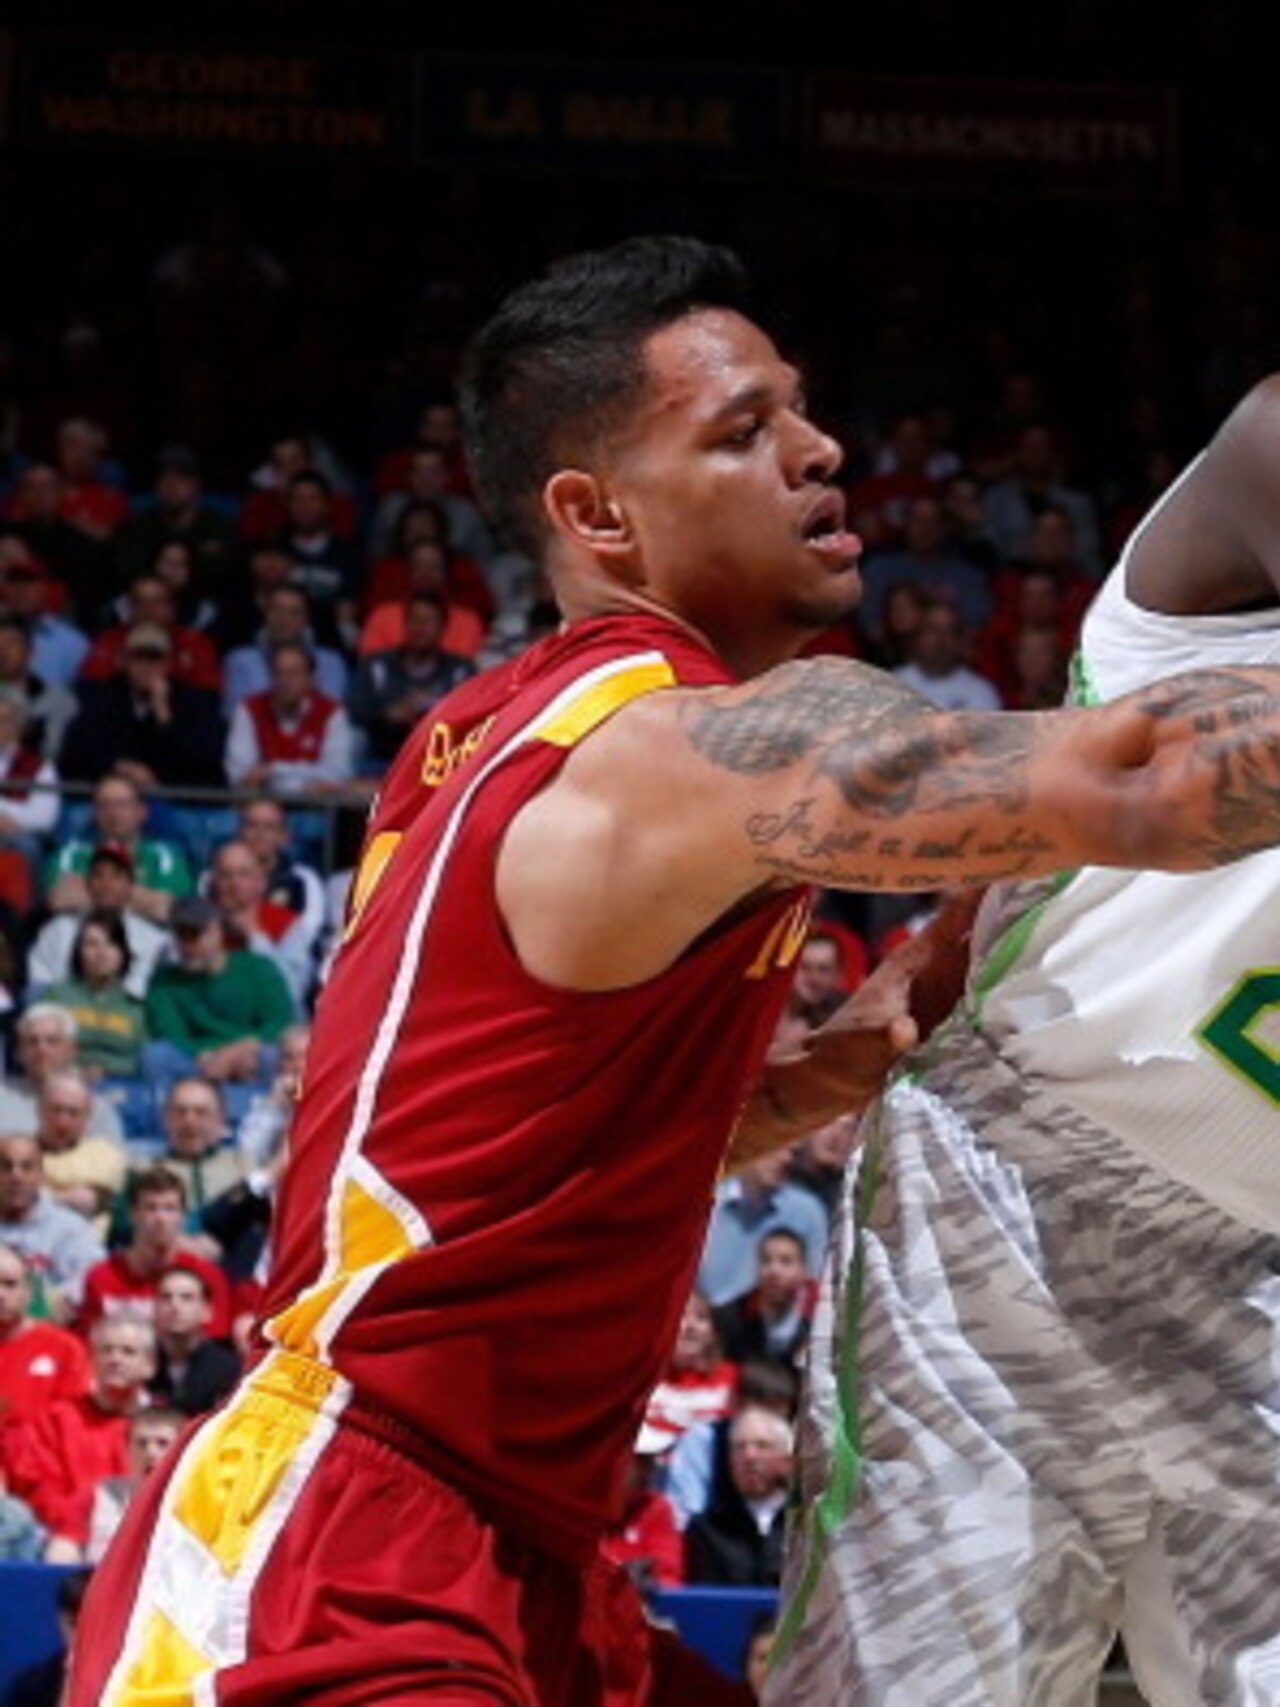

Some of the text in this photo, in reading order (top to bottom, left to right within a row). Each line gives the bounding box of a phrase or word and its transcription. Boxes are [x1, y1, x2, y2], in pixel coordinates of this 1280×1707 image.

[107, 49, 320, 100] GEORGE
[40, 91, 392, 149] WASHINGTON
[464, 84, 544, 141] LA
[818, 108, 1157, 165] MASSACHUSETTS
